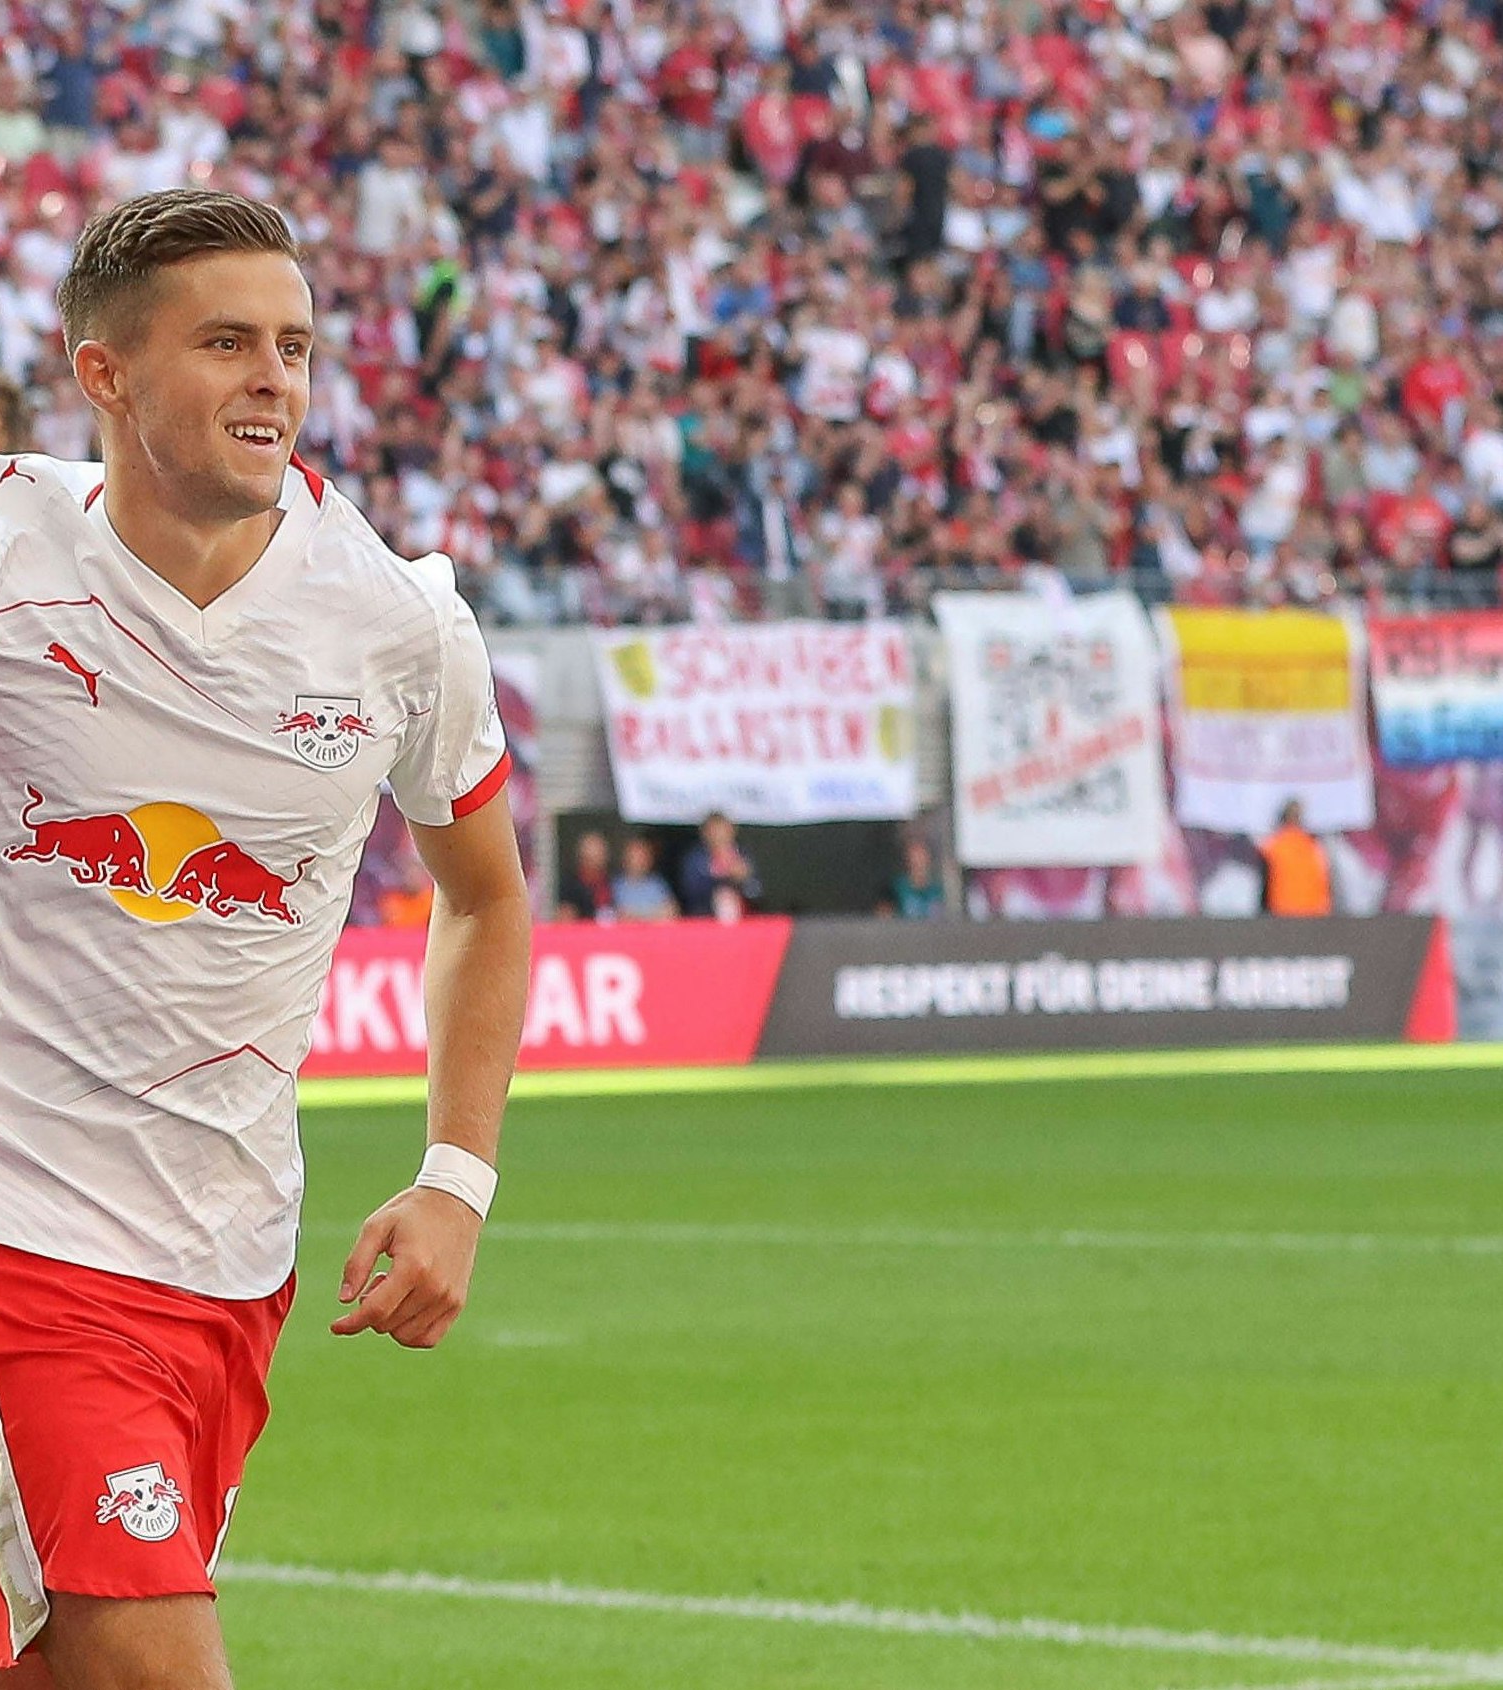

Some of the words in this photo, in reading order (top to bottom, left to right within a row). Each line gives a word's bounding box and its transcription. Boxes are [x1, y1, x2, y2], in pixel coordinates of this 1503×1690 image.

[315, 739, 354, 761] LEIPZIG
[835, 963, 1009, 1018] RESPEKT
[1014, 953, 1092, 1013] FÜR
